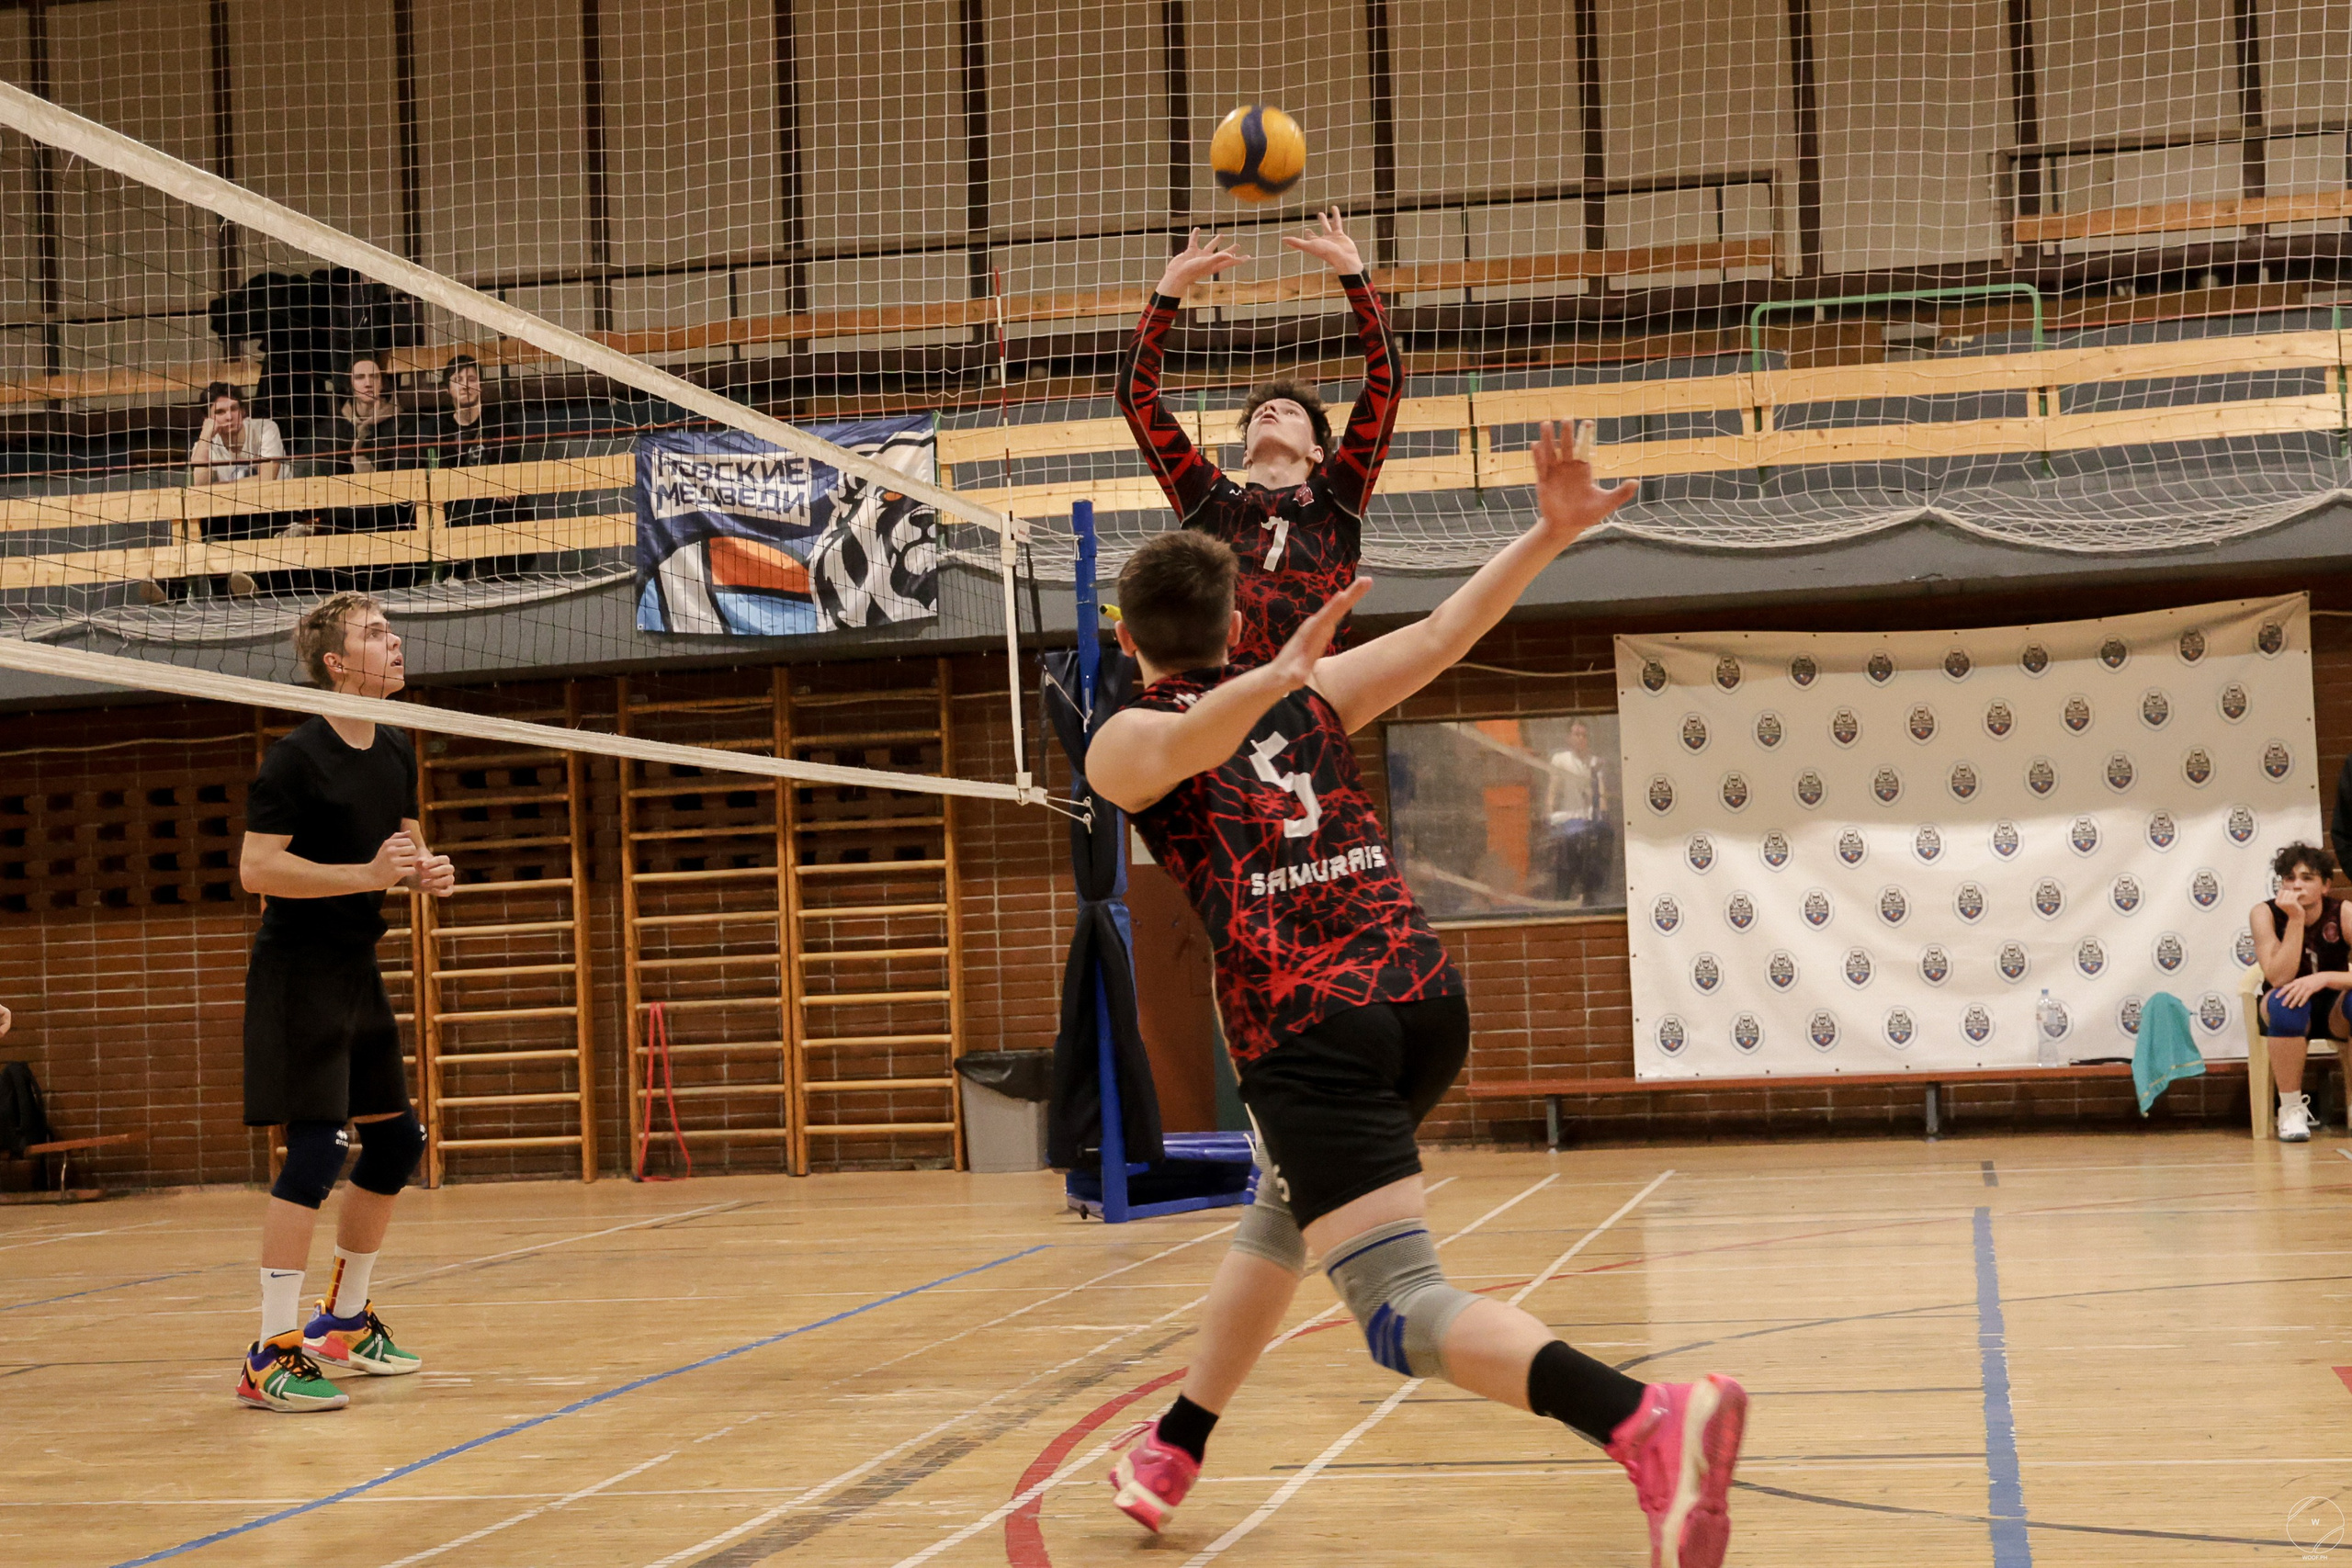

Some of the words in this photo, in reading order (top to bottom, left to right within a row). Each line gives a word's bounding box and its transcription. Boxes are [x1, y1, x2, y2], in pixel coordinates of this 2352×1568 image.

[657, 481, 806, 518] МЕДВЕДИ
[1249, 731, 1322, 838] 5
[1250, 845, 1387, 897] SAMURAIS
